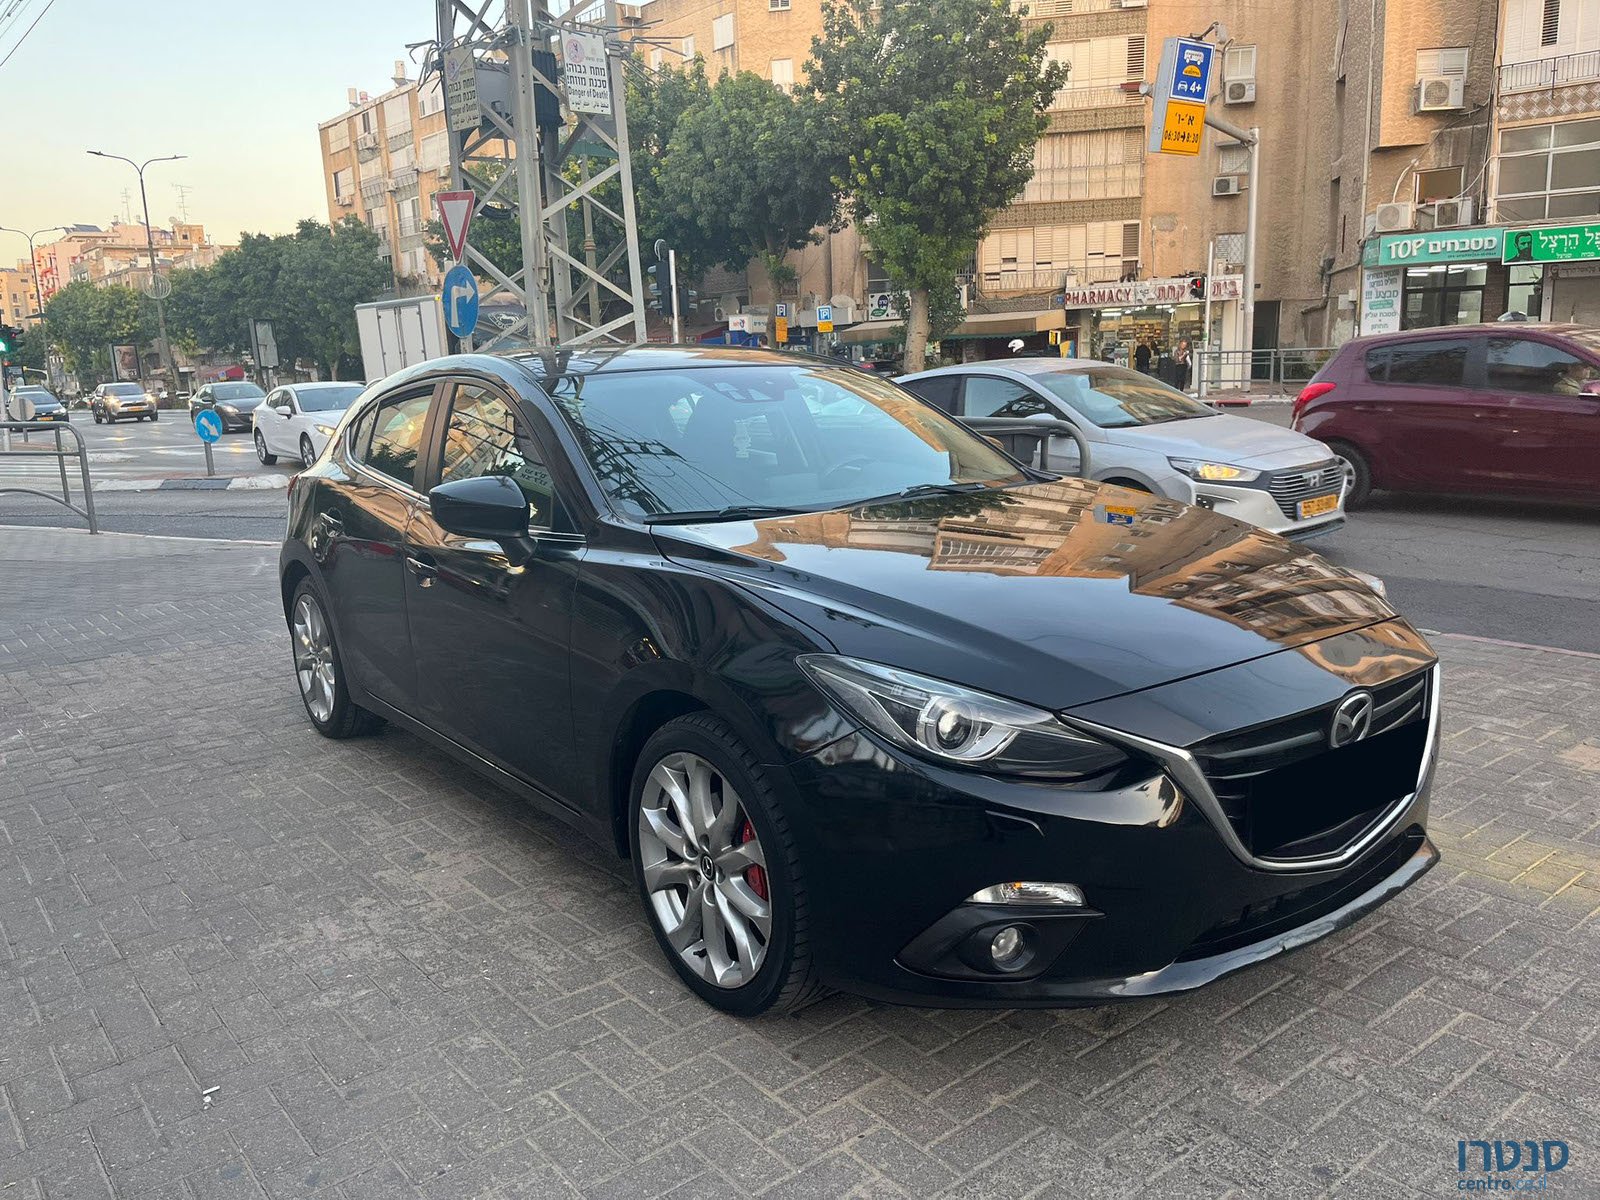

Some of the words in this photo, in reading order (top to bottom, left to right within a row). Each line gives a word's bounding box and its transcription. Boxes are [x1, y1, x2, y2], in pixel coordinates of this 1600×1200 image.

[589, 65, 606, 77] מתח
[588, 77, 607, 89] סכנת
[568, 86, 586, 98] Danger
[586, 89, 592, 98] of
[1387, 238, 1426, 259] TOP
[1212, 280, 1240, 296] בית
[1375, 289, 1399, 299] מבצע
[1065, 287, 1132, 305] PHARMACY
